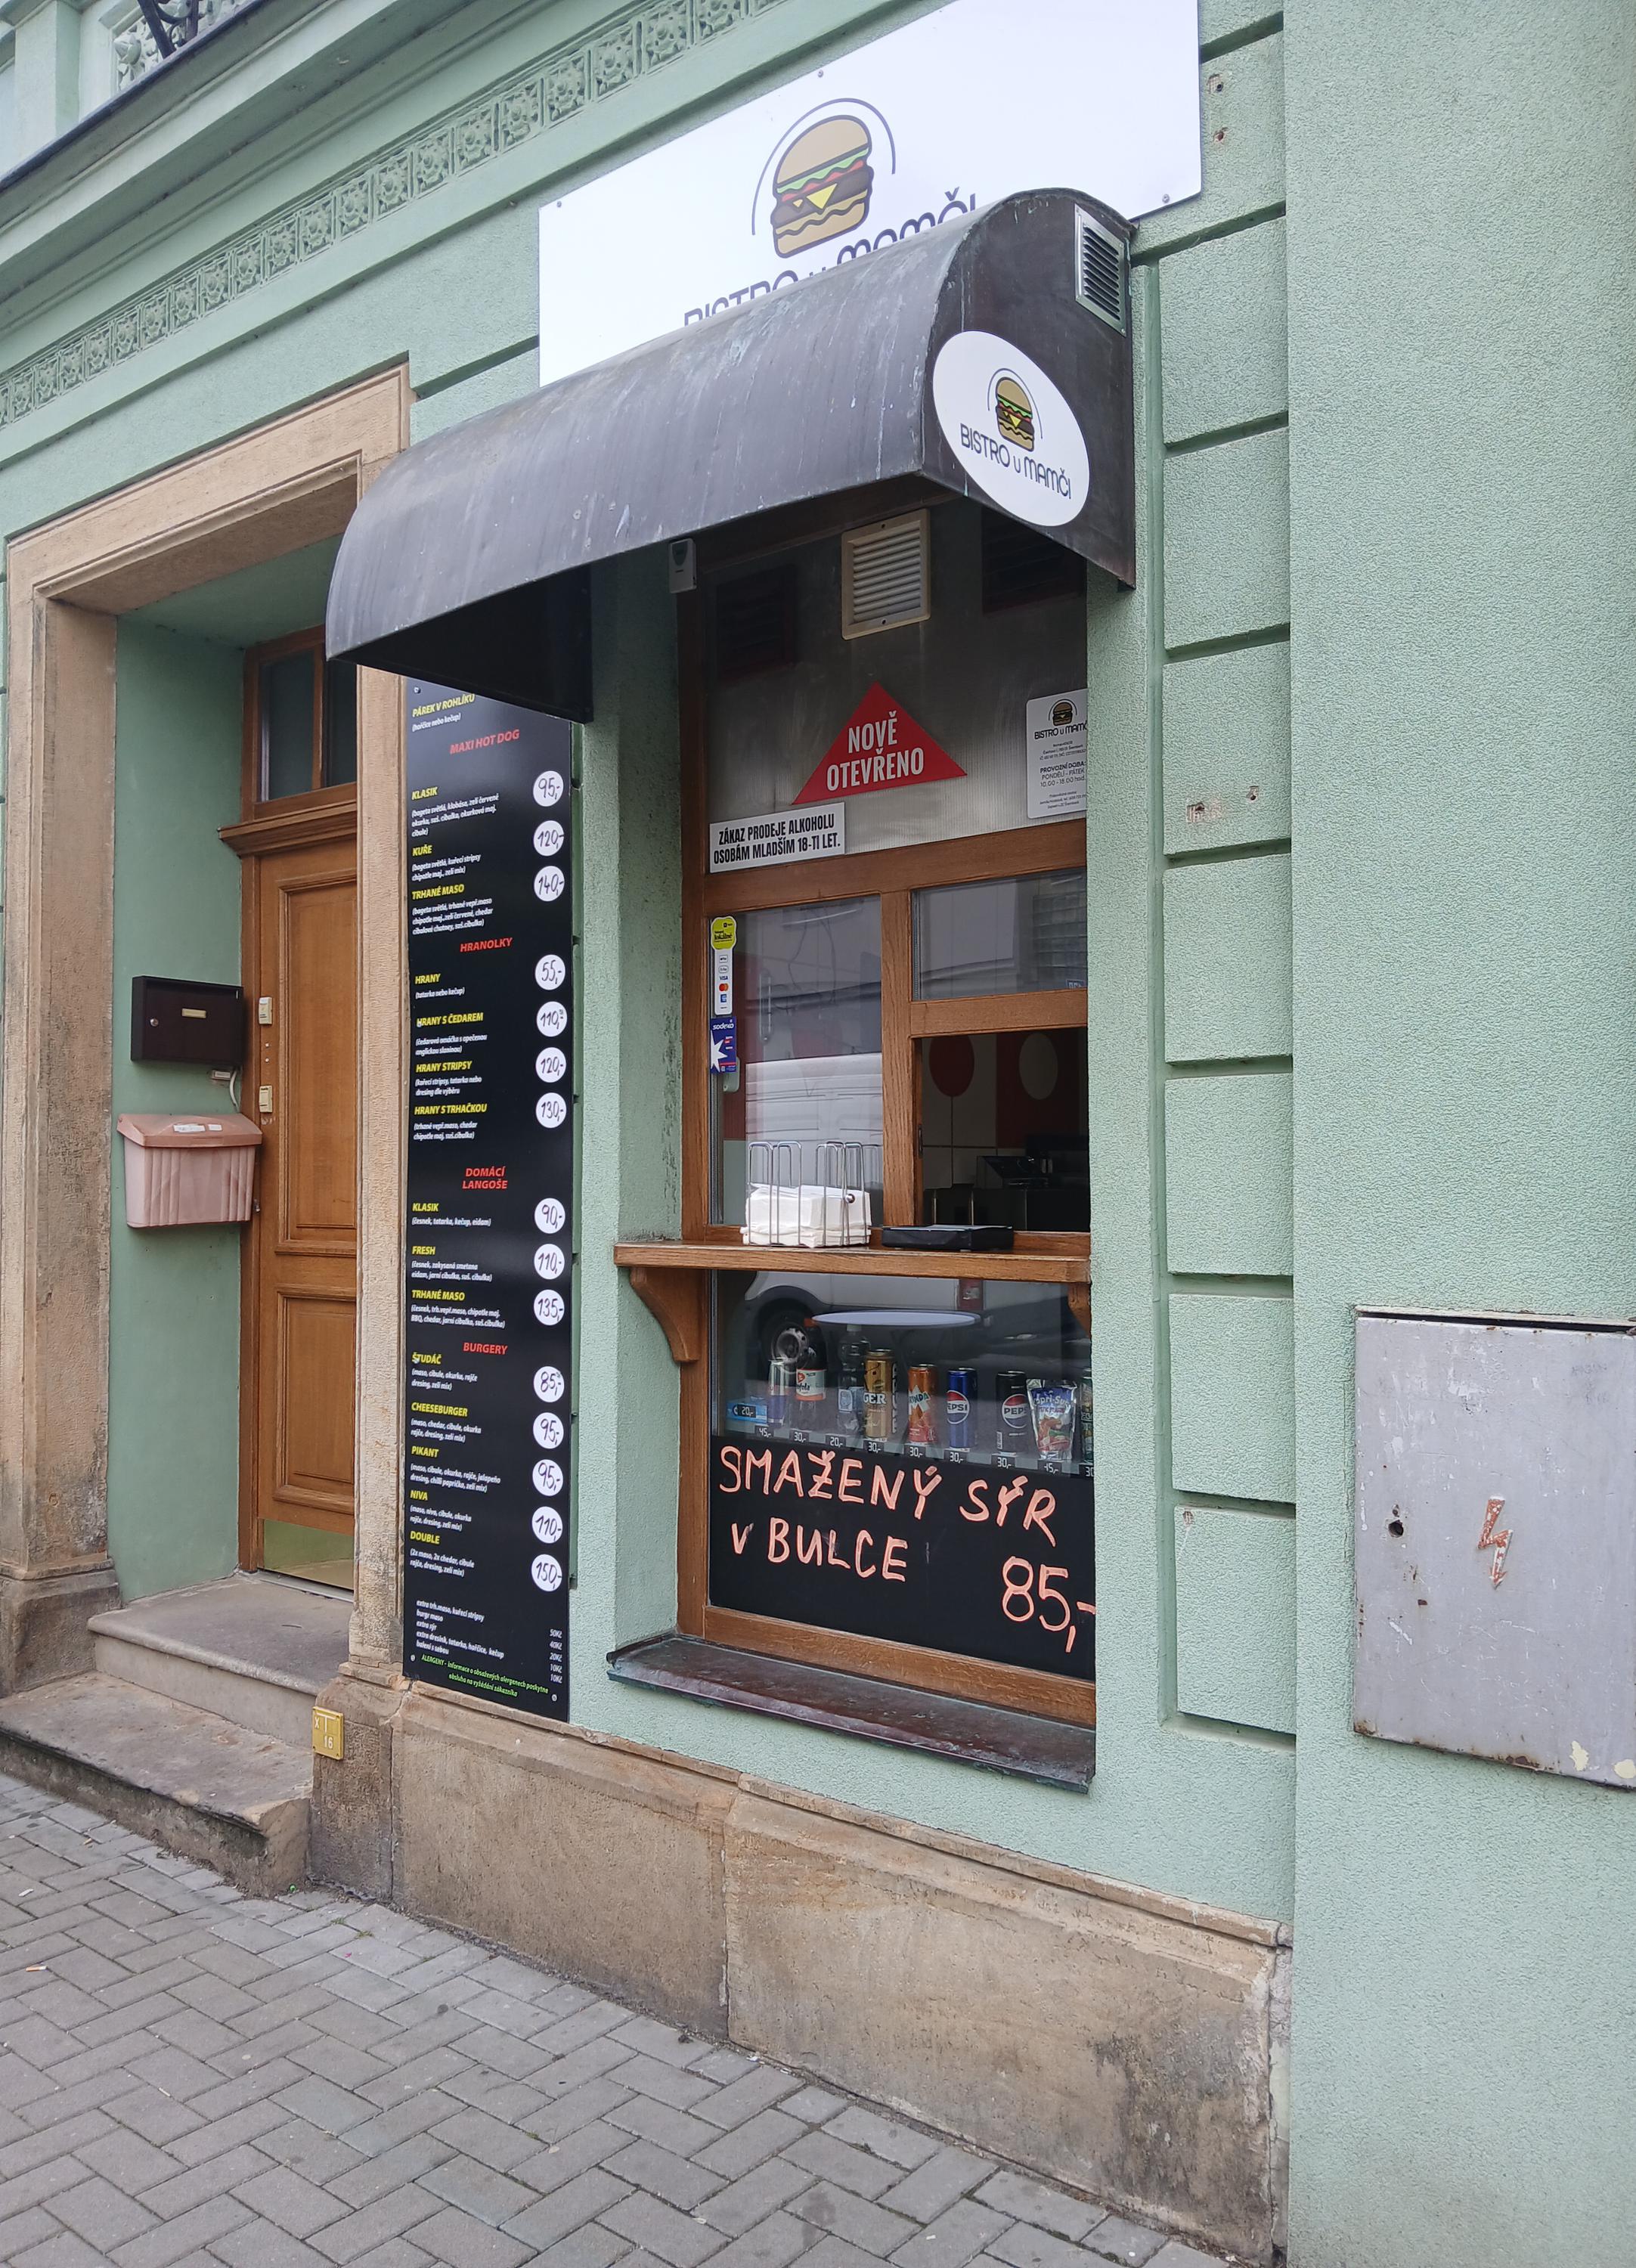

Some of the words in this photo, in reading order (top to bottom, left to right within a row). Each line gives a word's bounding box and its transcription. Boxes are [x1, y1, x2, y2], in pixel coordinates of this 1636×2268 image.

[960, 423, 1010, 467] BISTRO
[1024, 457, 1071, 499] MAMČI
[412, 702, 435, 717] PÁREK
[436, 702, 442, 711] V
[442, 694, 475, 709] ROHLÍKU
[848, 711, 897, 753] NOVĚ
[1034, 728, 1058, 740] BISTRO
[450, 740, 475, 754] MAXI
[476, 736, 495, 749] HOT
[497, 730, 519, 743] DOG
[827, 748, 924, 791] OTEVŘENO
[1040, 762, 1067, 773] PROVOZNÍ
[412, 786, 438, 800] KLASIK
[719, 827, 745, 845] ZÁKAZ
[748, 822, 785, 841] PRODEJE
[789, 813, 835, 835] ALKOHOLU
[412, 844, 432, 856] KUŘE
[714, 845, 749, 864] OSOBÁM
[753, 837, 795, 859] MLADŠÍM
[798, 835, 820, 852] 18-TI
[823, 833, 841, 849] LET.
[412, 885, 442, 900] TRHANÉ
[442, 884, 464, 895] MASO
[460, 937, 513, 953] HRANOLKY
[415, 974, 441, 984] HRANY
[417, 1016, 442, 1027] HRANY
[442, 1015, 447, 1024] S
[448, 1012, 484, 1024] ČEDAREM
[417, 1064, 442, 1073] HRANY
[442, 1061, 472, 1071] STRIPSY
[414, 1106, 440, 1115] HRANY
[466, 1166, 506, 1177] DOMÁCÍ
[462, 1179, 507, 1189] LANGOŠE
[412, 1247, 435, 1255] FRESH
[412, 1290, 442, 1300] TRHANÉ
[442, 1291, 465, 1301] MASO
[463, 1342, 507, 1355] BURGERY
[412, 1352, 442, 1365] ŠTUDÁČ
[411, 1402, 468, 1417] CHEESEBURGER
[411, 1446, 439, 1458] PIKANT
[410, 1490, 428, 1501] NIVA
[720, 1445, 943, 1520] SMAŽENÝ
[959, 1475, 1057, 1548] SÝR
[410, 1531, 440, 1545] DOUBLE
[767, 1517, 908, 1582] BULCE
[422, 1654, 444, 1666] ALERGENY
[314, 1717, 320, 1729] X
[324, 1736, 333, 1749] 16
